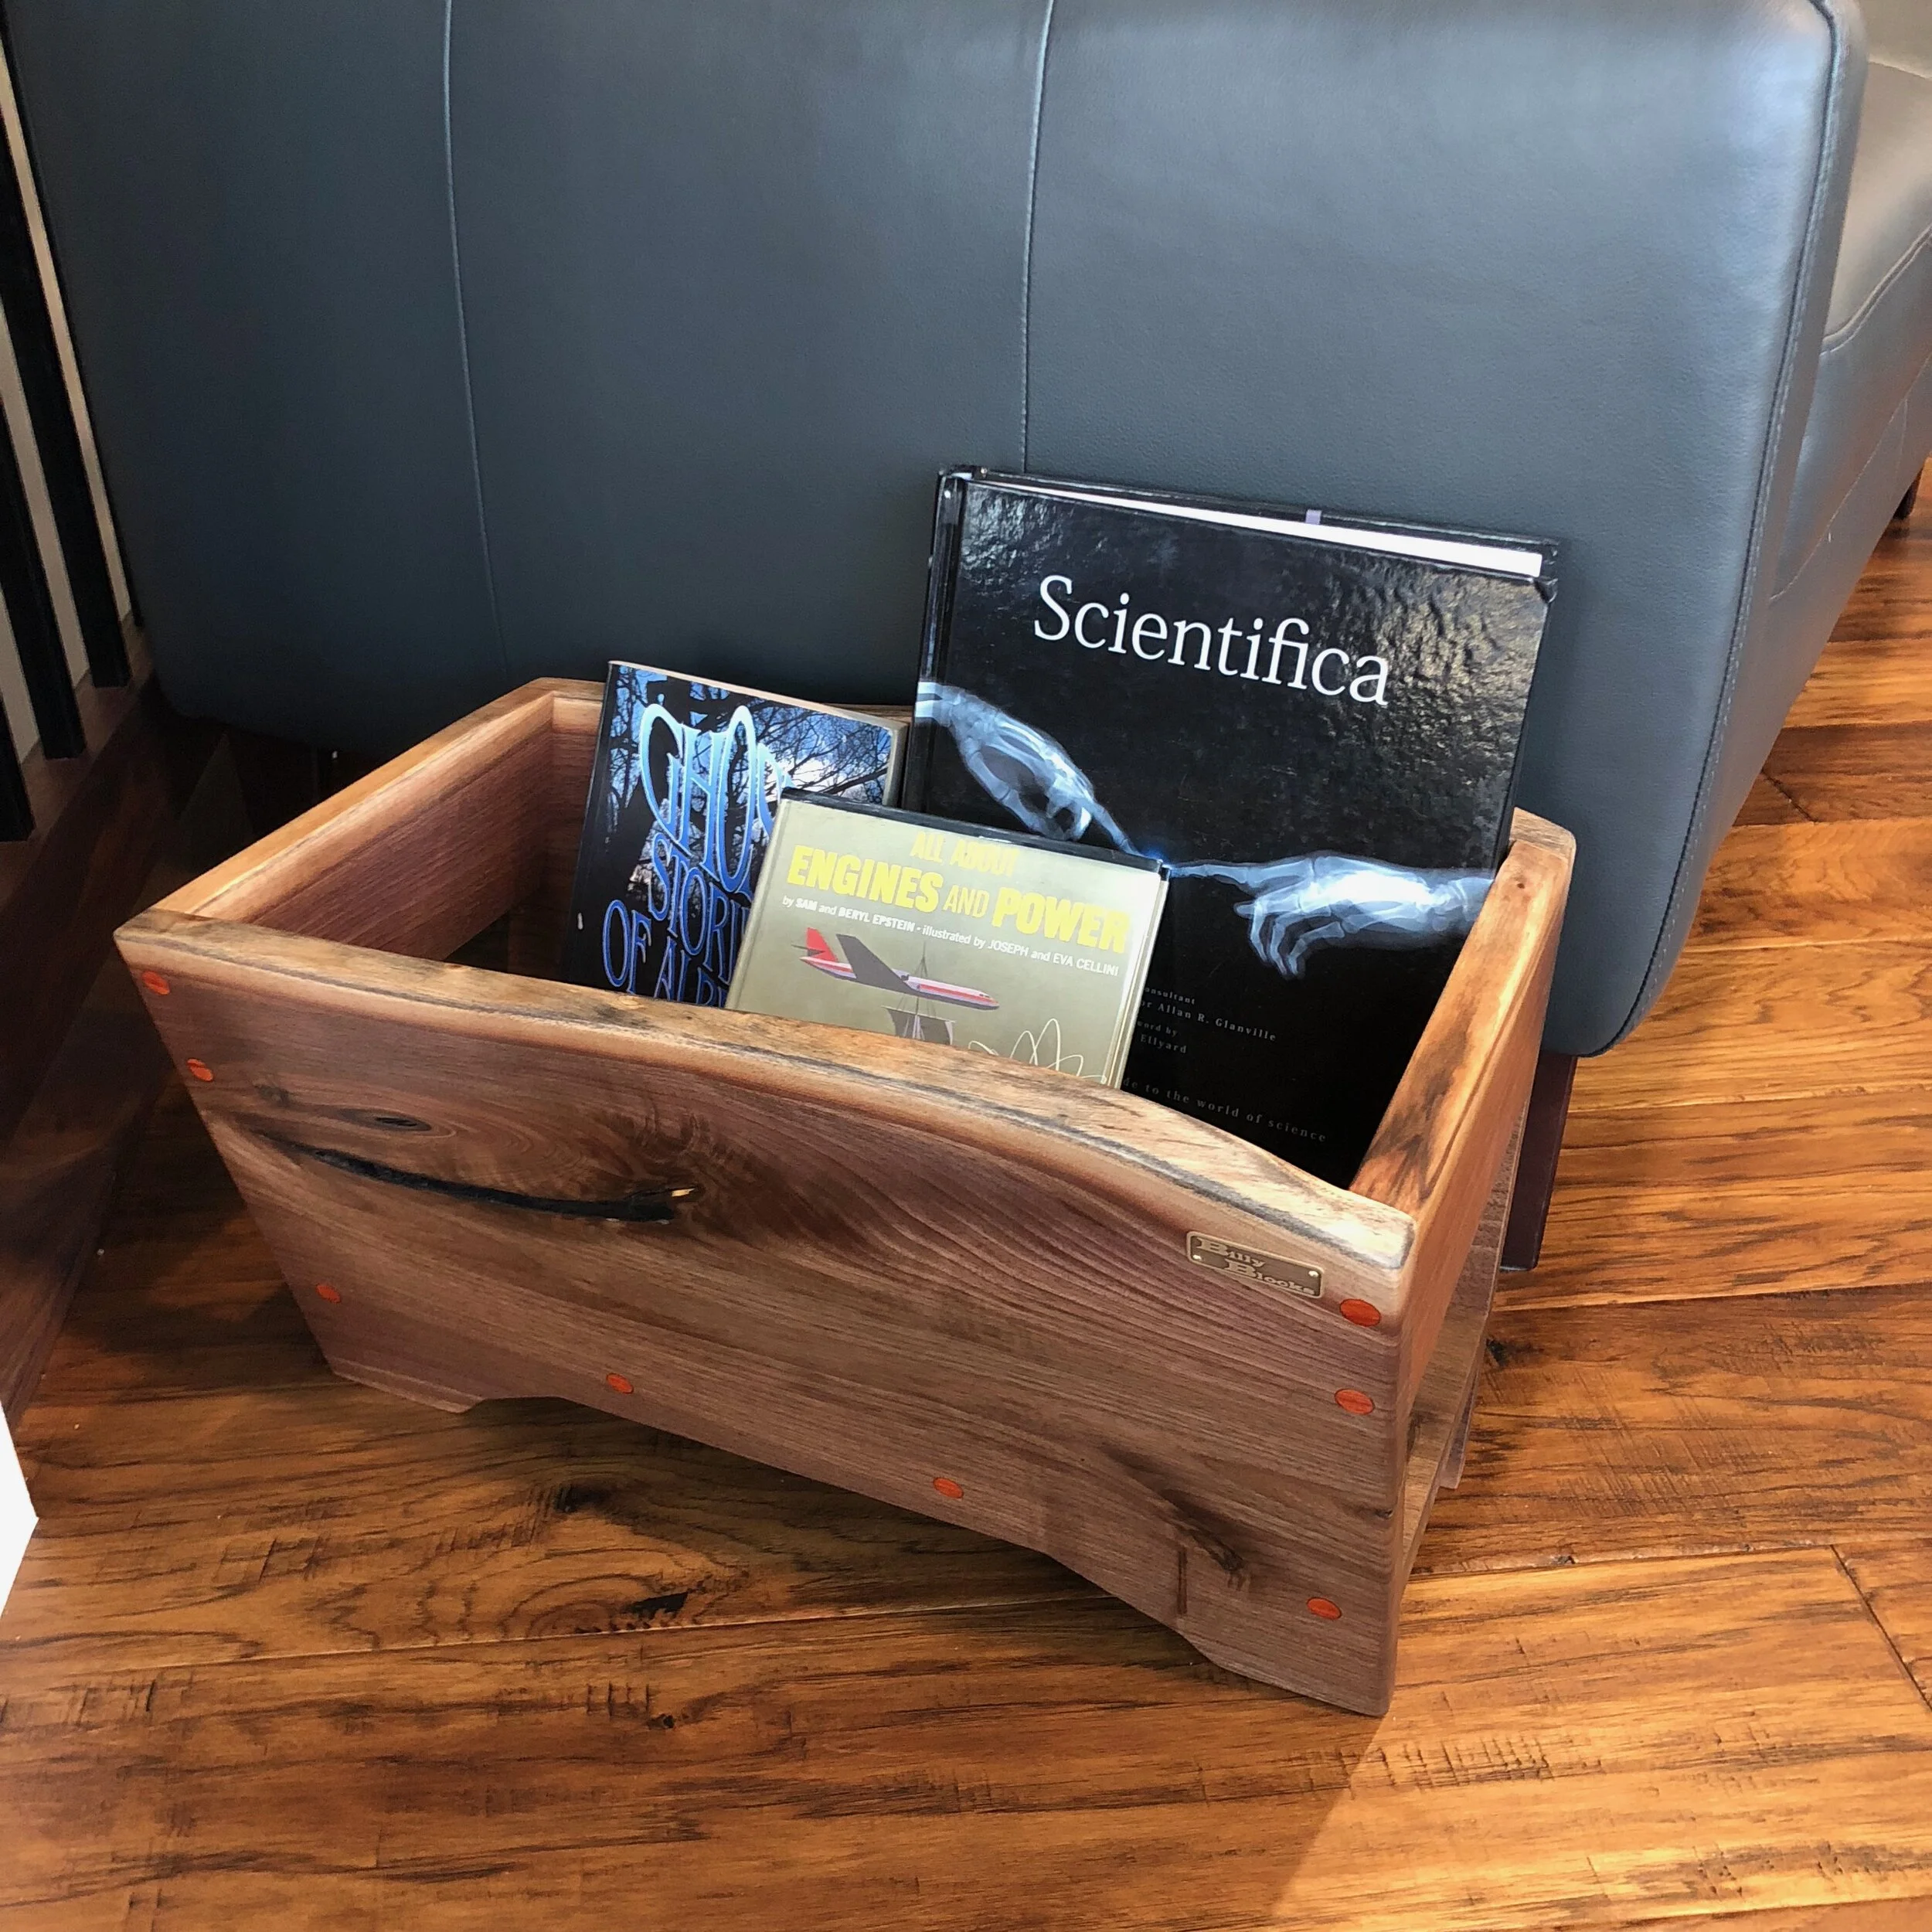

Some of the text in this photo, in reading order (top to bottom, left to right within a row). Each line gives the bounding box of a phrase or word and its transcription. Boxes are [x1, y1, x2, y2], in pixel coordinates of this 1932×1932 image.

[1034, 574, 1389, 706] Scientifica
[910, 831, 1021, 877] ALL ABOUT
[787, 845, 1131, 954] ENGINES AND POWER
[602, 900, 651, 993] OF
[782, 895, 1119, 977] by SAM and BERYL EPSTEIN illustrated by JOSEPH and EVA CELLINI
[1143, 987, 1196, 1005] onsultant
[1158, 1003, 1192, 1019] Allan
[1215, 1018, 1276, 1042] Glanville
[1145, 1083, 1327, 1144] to the world of science
[1197, 1236, 1266, 1267] Billy
[1225, 1258, 1315, 1295] Blocks
